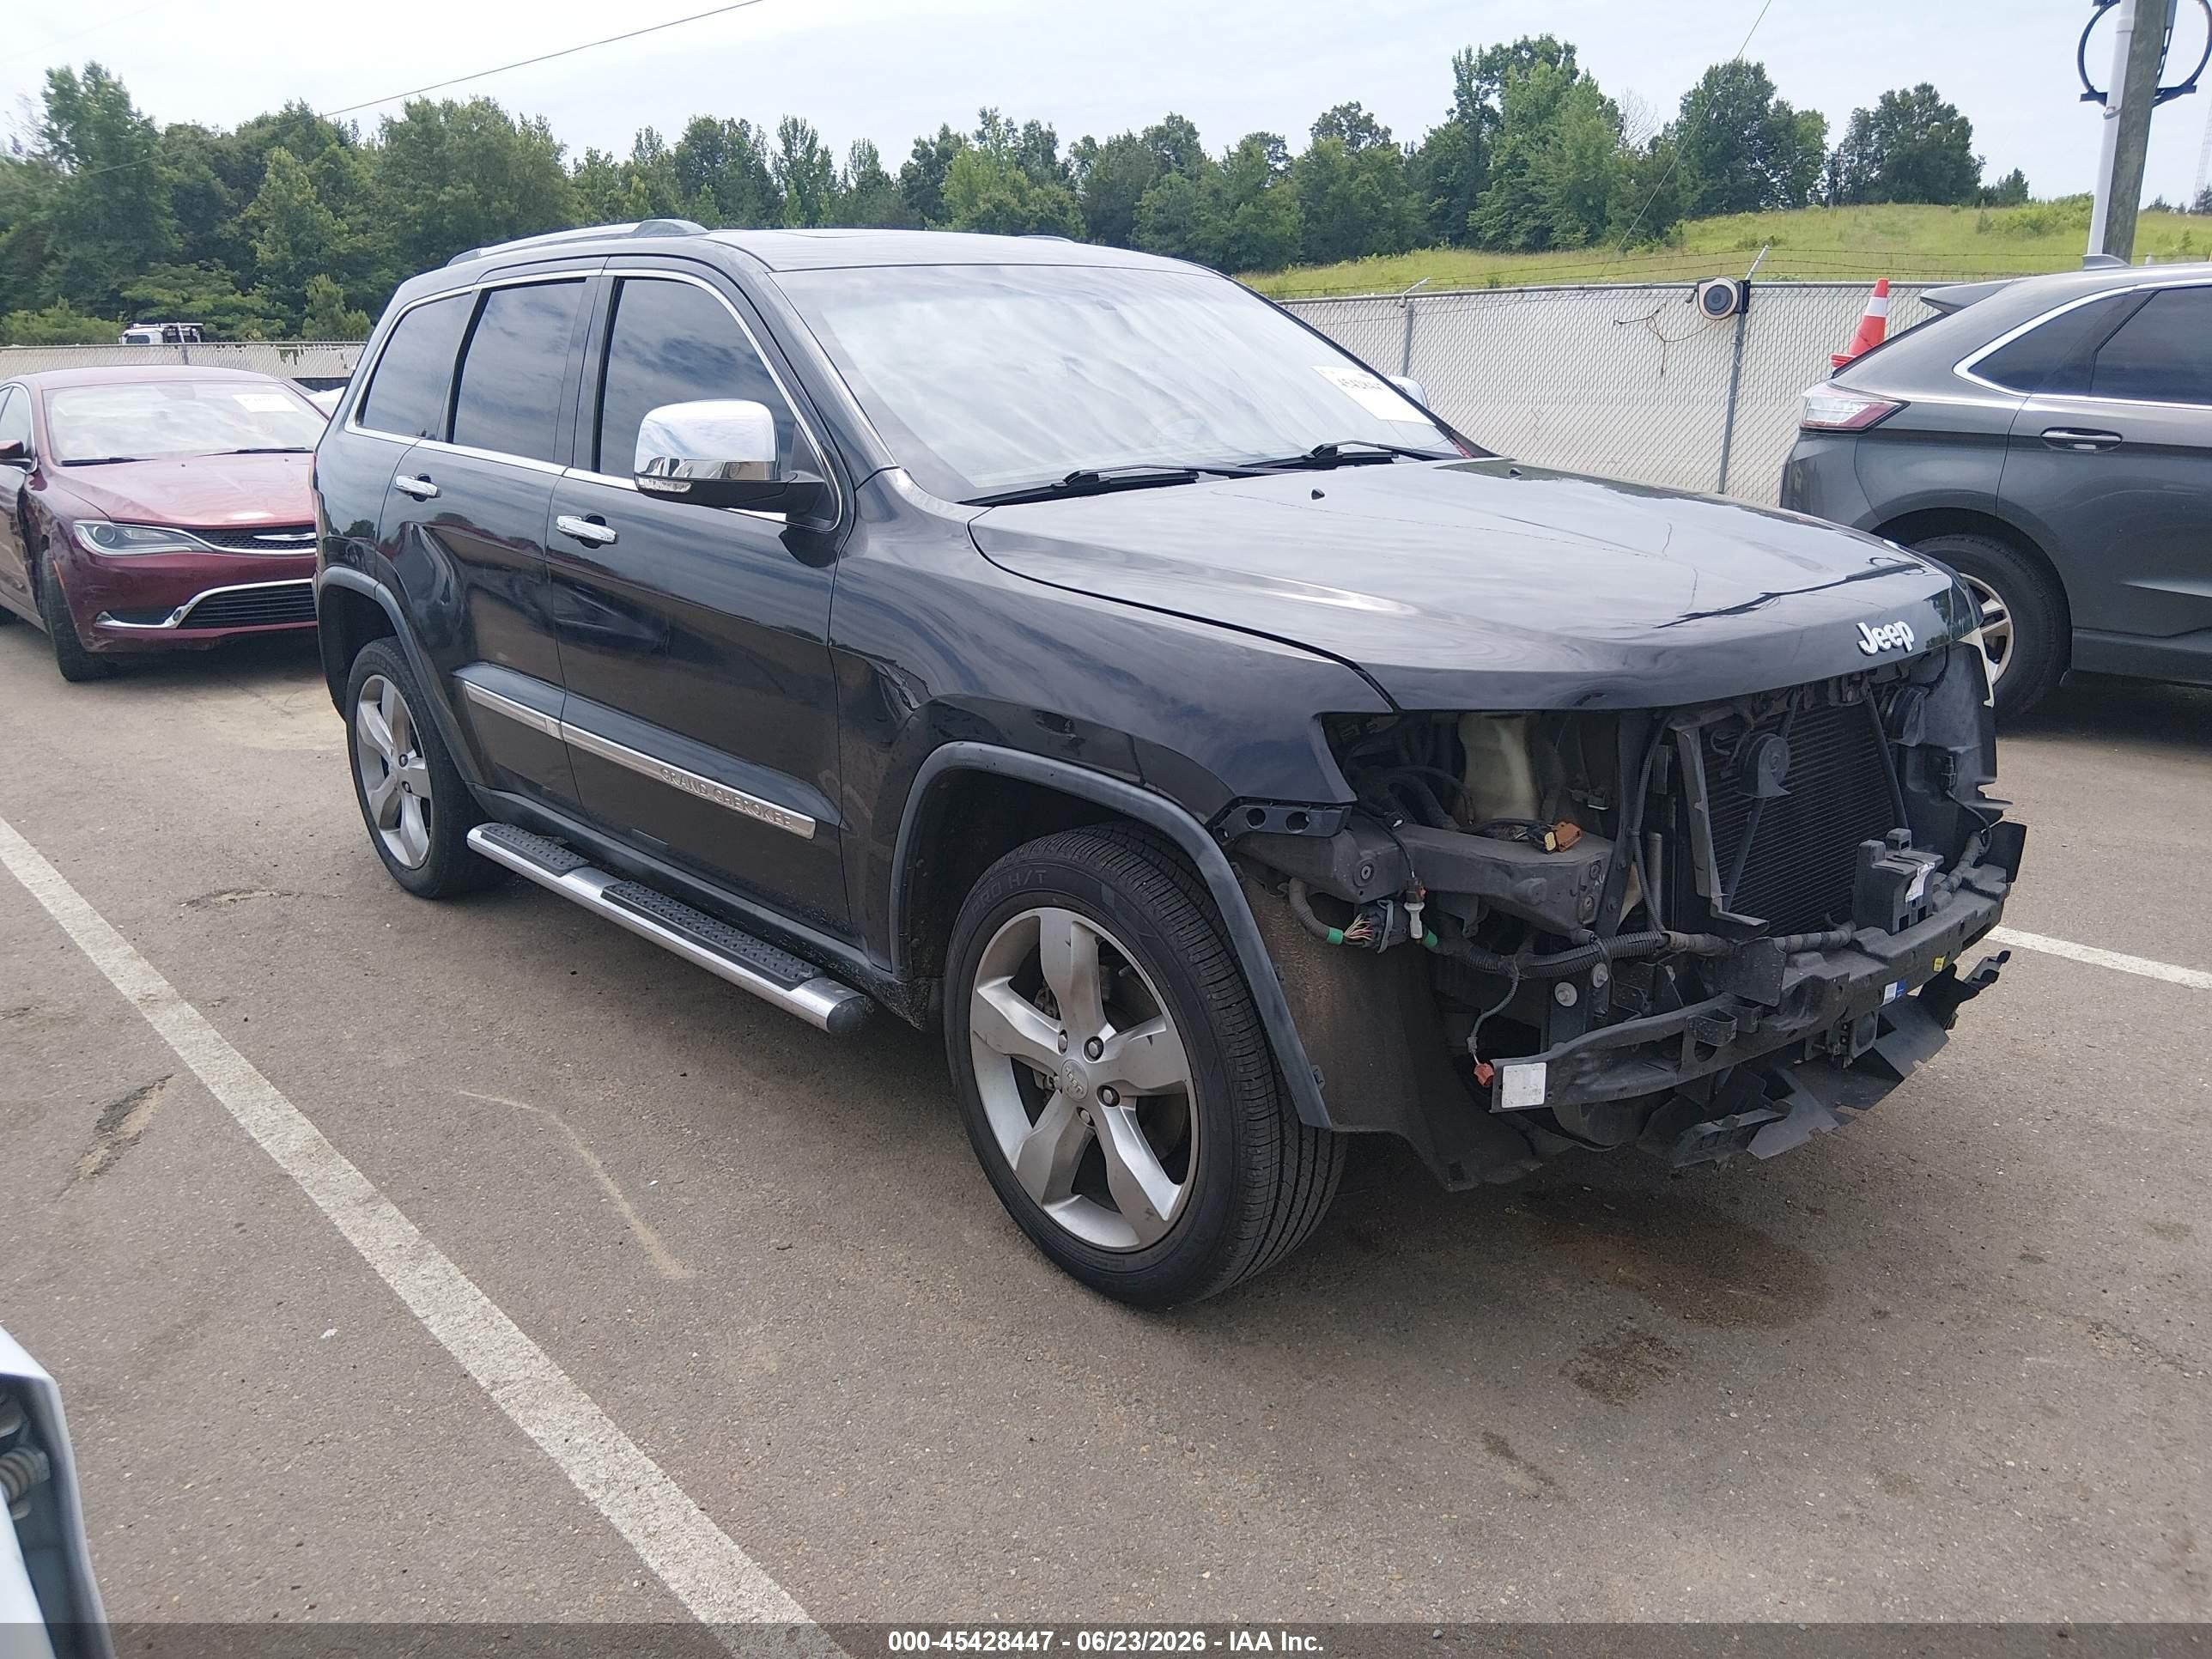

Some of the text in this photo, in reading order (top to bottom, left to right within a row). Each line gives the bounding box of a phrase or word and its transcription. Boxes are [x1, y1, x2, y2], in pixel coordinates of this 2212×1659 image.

[1856, 620, 1915, 656] Jeep
[659, 767, 793, 831] GRAND CHEROKEE
[1008, 869, 1047, 890] H/T
